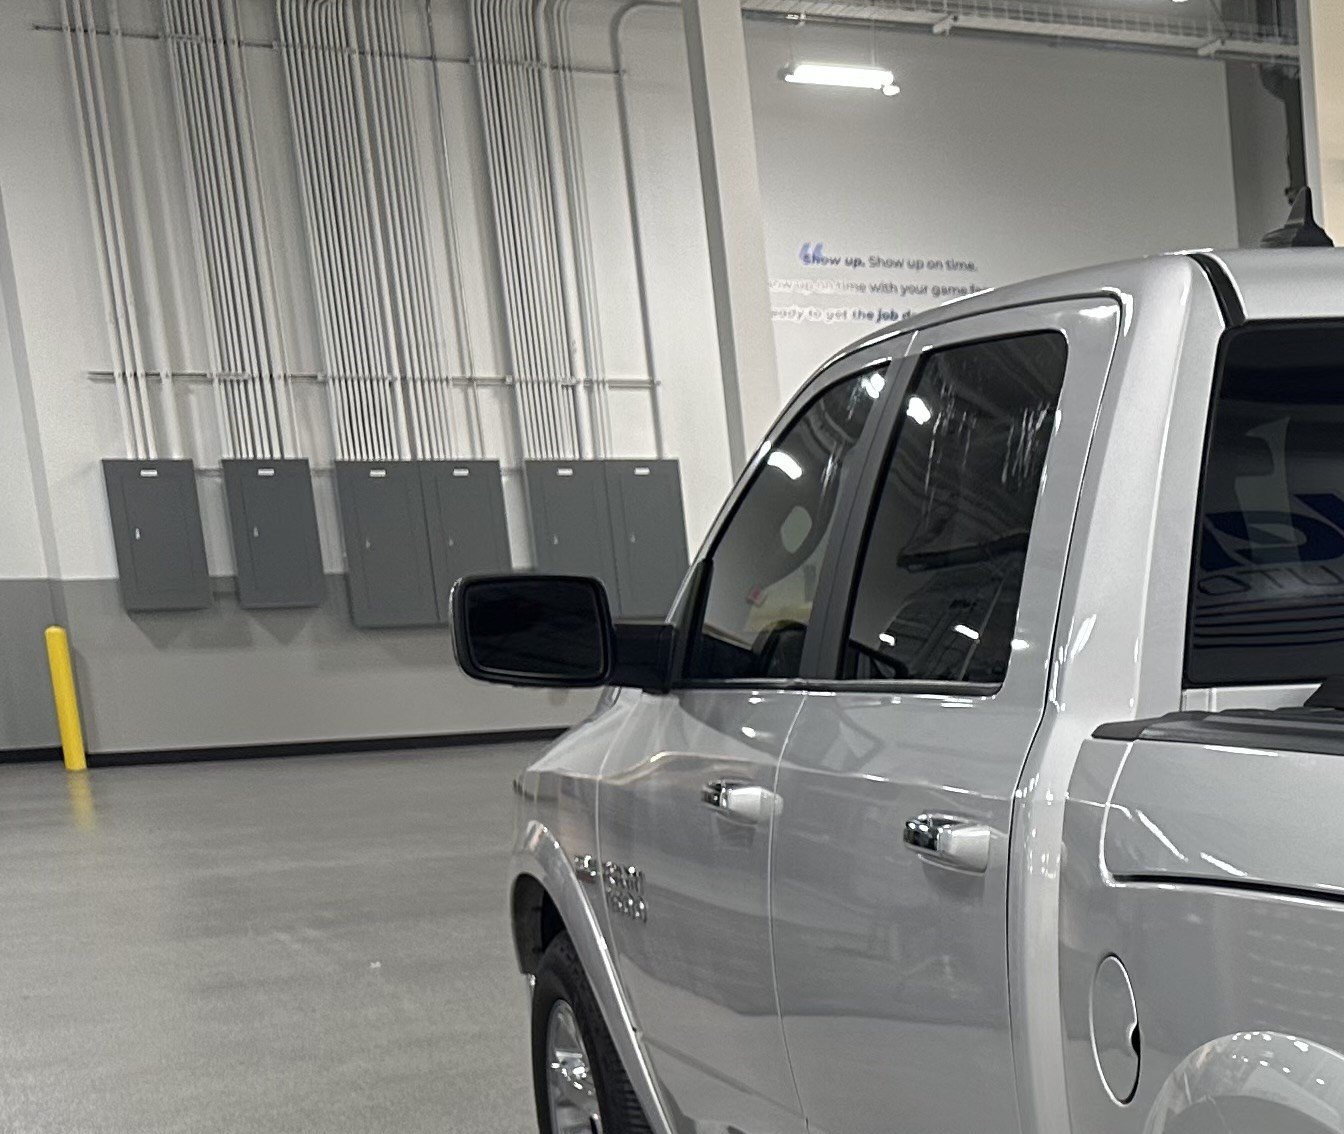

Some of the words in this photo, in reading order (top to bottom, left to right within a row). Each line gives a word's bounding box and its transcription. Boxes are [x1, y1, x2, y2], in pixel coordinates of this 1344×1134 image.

[868, 254, 904, 268] Show
[906, 259, 924, 271] up
[926, 259, 943, 270] on
[869, 283, 898, 294] with
[900, 284, 928, 297] your
[931, 285, 968, 298] game
